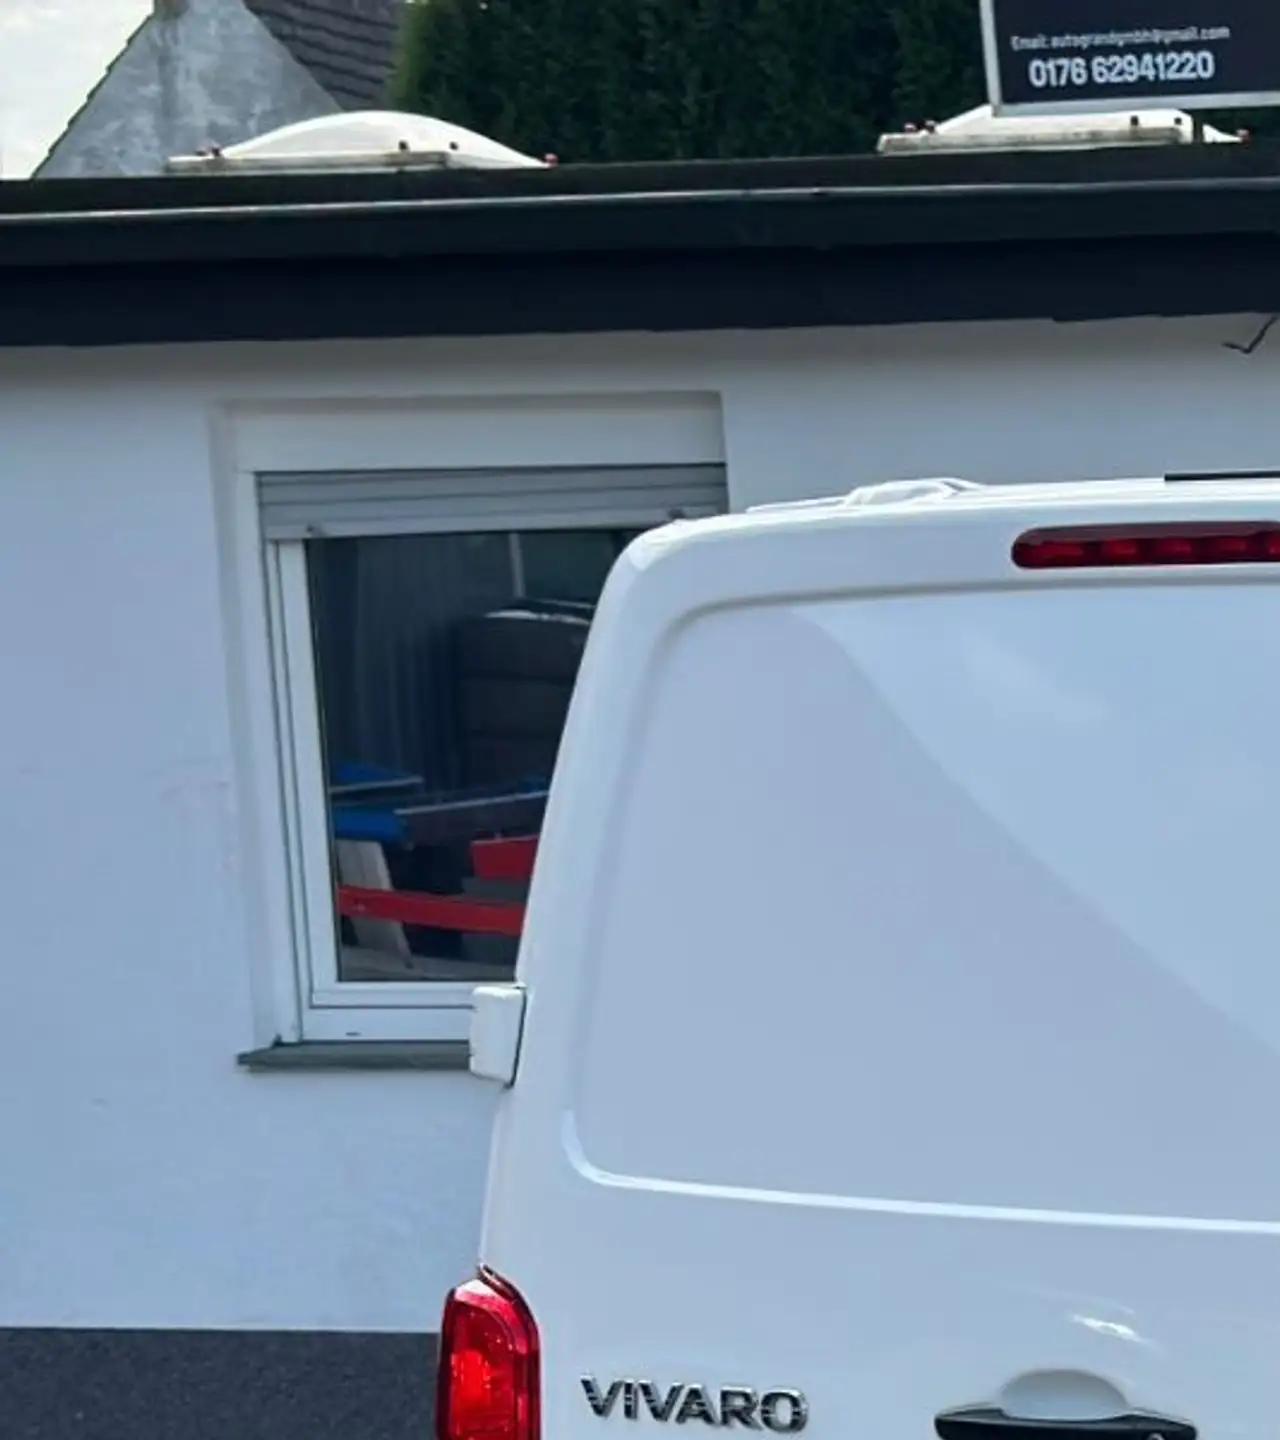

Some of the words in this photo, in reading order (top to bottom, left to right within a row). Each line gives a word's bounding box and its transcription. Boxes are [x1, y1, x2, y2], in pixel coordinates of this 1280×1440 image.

[1029, 57, 1088, 87] 0176
[1091, 51, 1215, 83] 62941220
[580, 1375, 809, 1433] VIVARO
